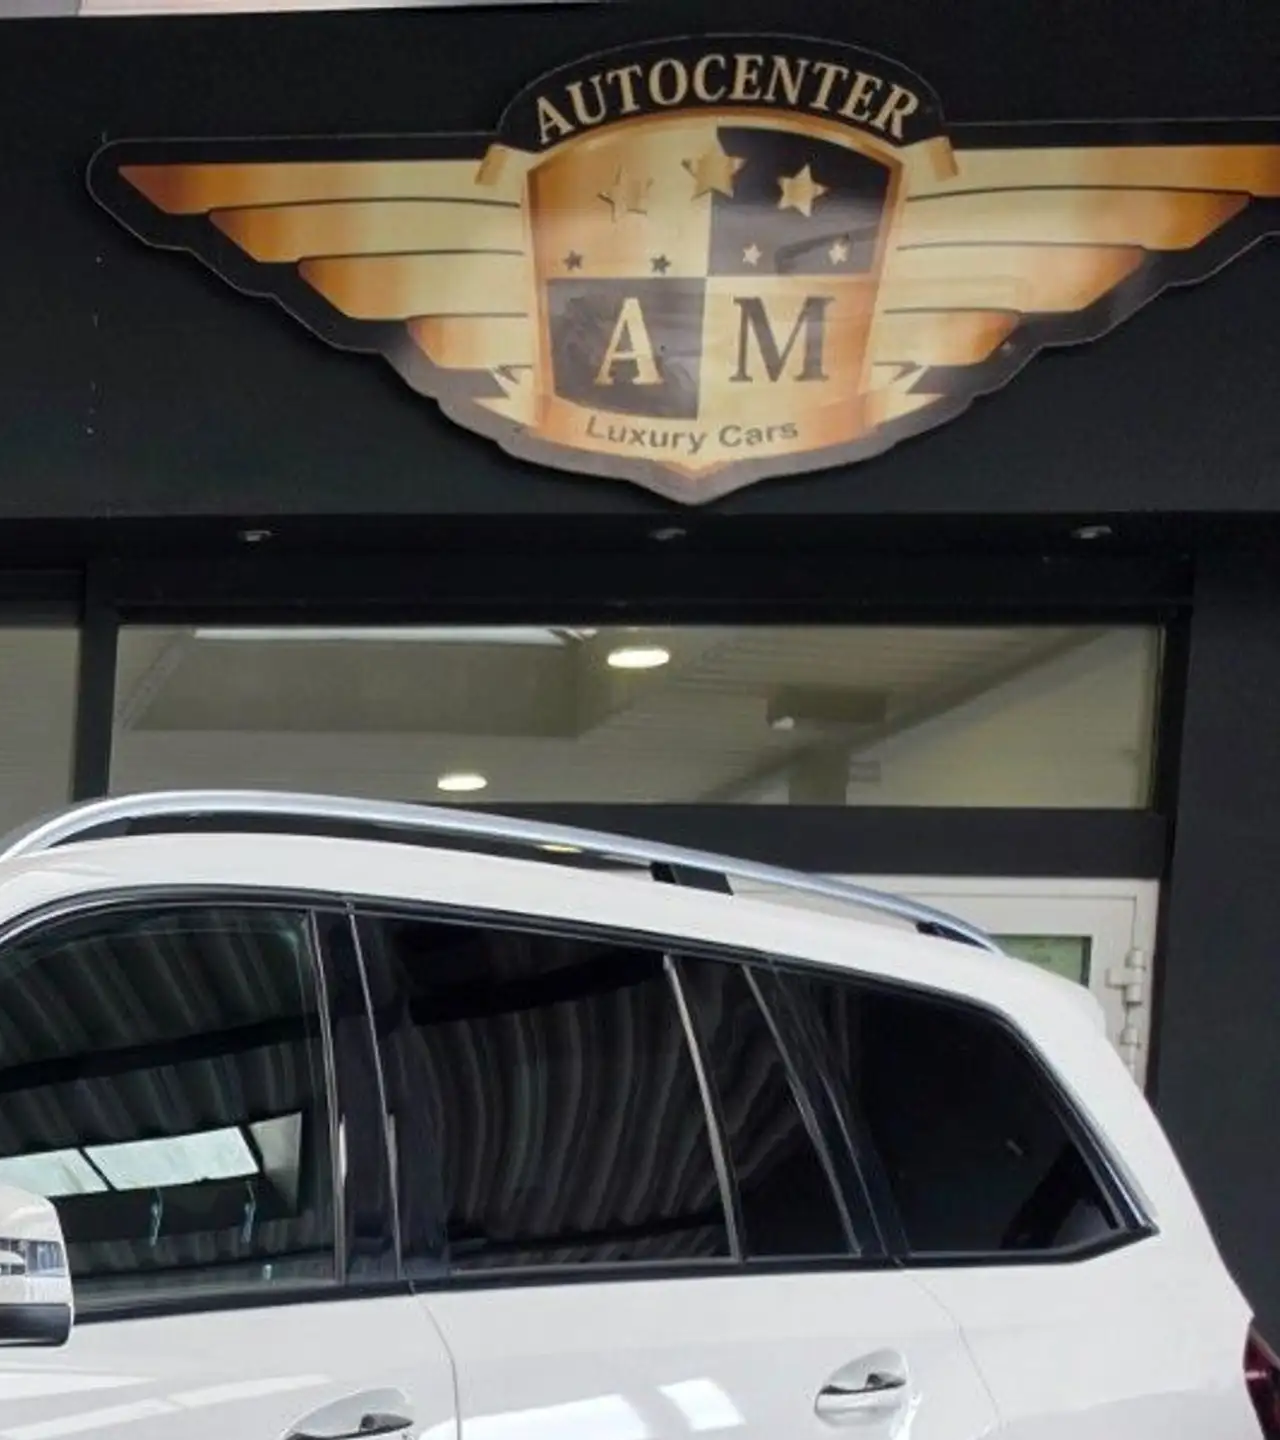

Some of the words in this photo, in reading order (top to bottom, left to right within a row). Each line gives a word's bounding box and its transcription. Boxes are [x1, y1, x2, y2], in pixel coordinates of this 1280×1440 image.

[535, 53, 919, 143] AUTOCENTER
[593, 297, 664, 386] A
[728, 295, 836, 383] M
[585, 415, 708, 455] Luxury
[718, 420, 799, 448] Cars
